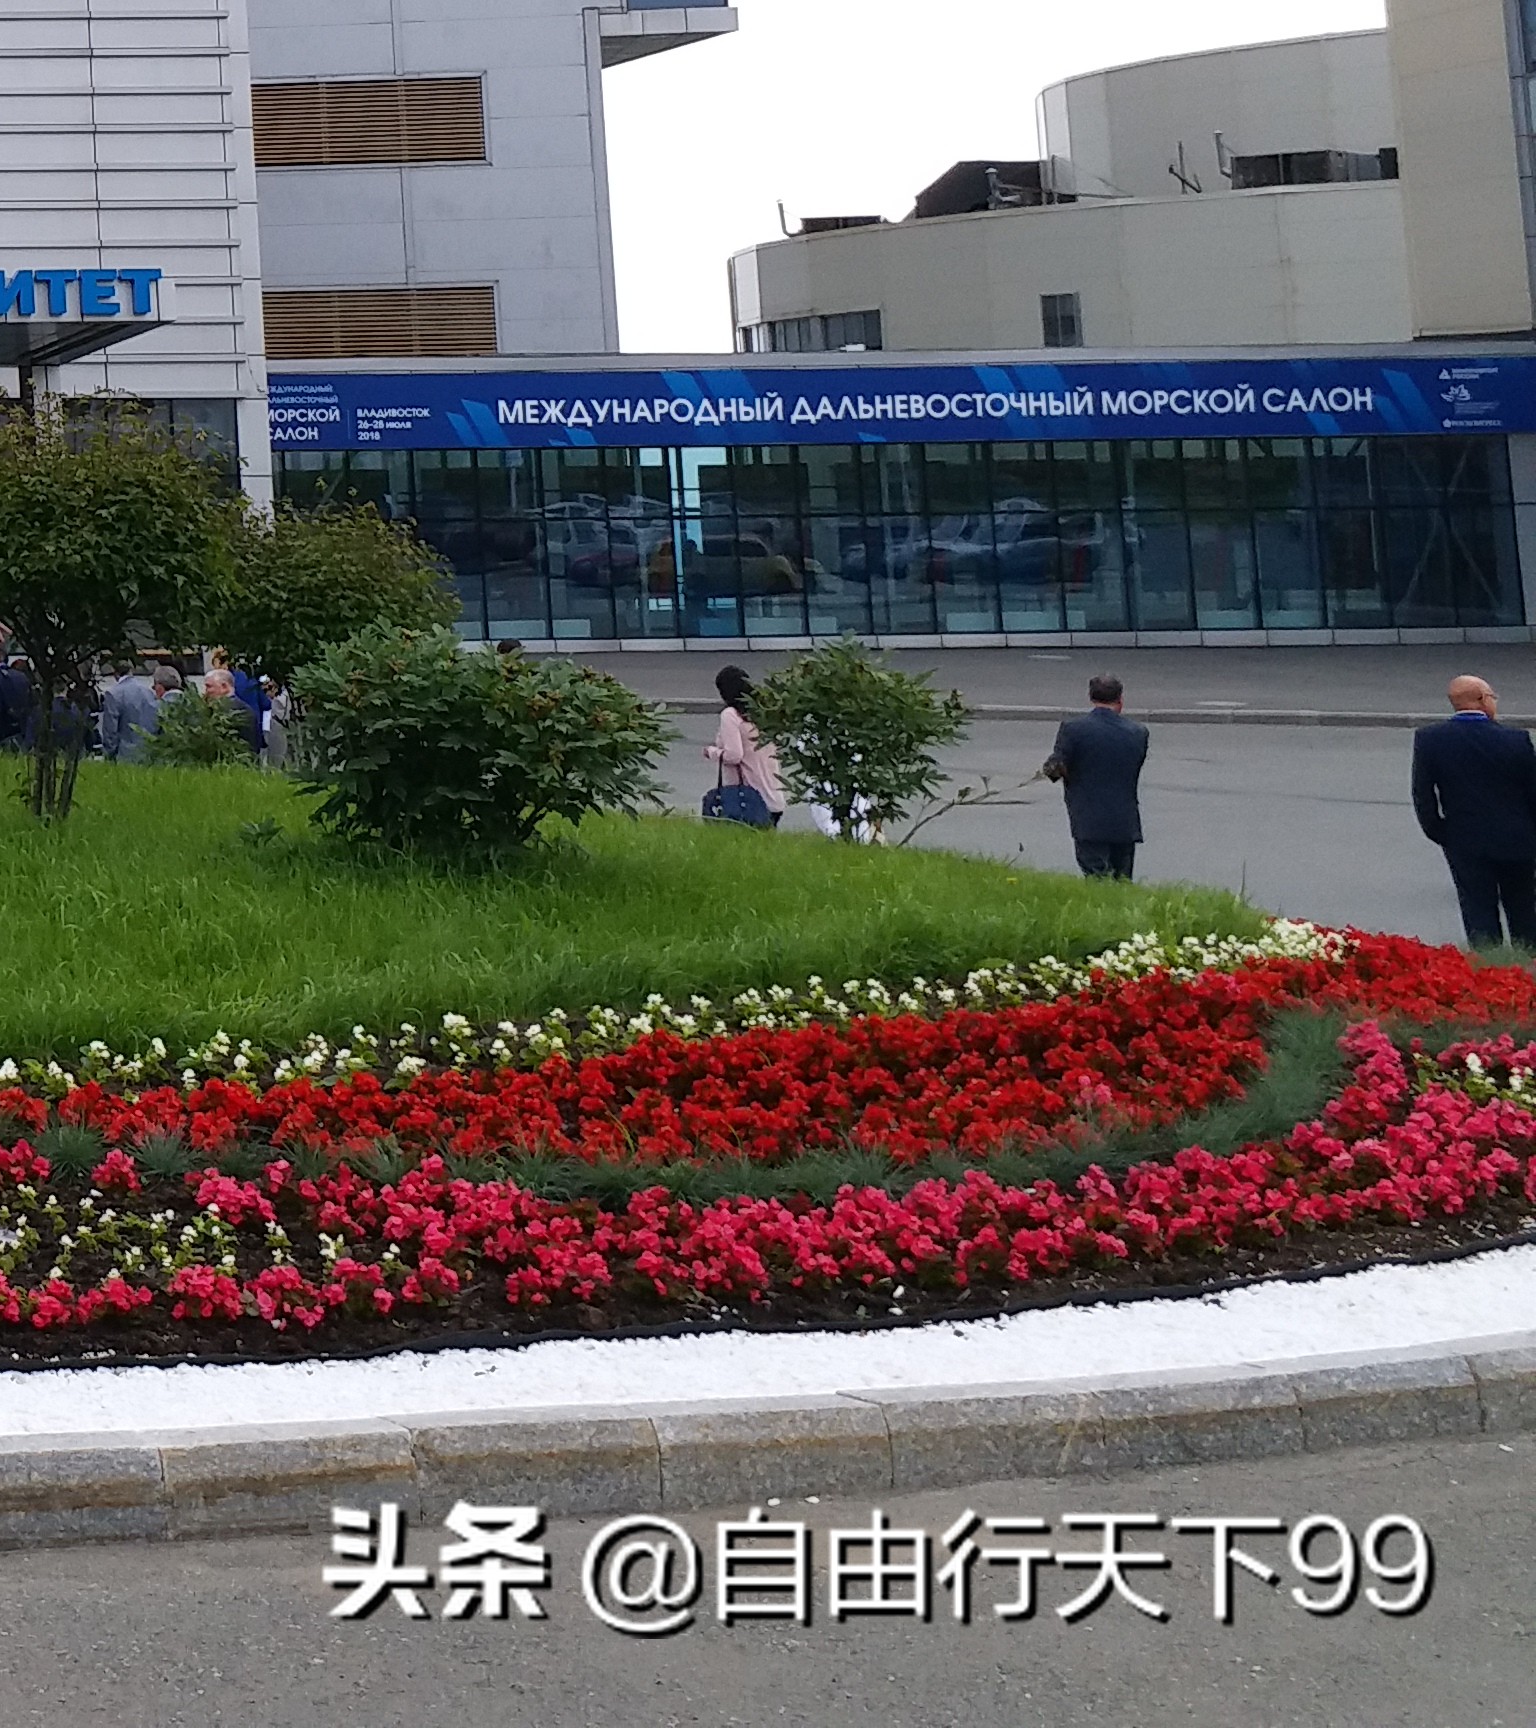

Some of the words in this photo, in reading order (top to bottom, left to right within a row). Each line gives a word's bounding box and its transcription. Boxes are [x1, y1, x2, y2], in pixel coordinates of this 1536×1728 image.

[497, 392, 784, 427] МЕЖДУНАРОДНЫЙ
[791, 385, 1094, 425] ДАЛЬНЕВОСТОЧНЫЙ
[1101, 384, 1256, 416] МОРСКОЙ
[1262, 386, 1374, 414] САЛОН
[356, 408, 431, 419] ВЛАДИВОСТОК
[385, 421, 412, 429] июля
[357, 431, 381, 441] 2018
